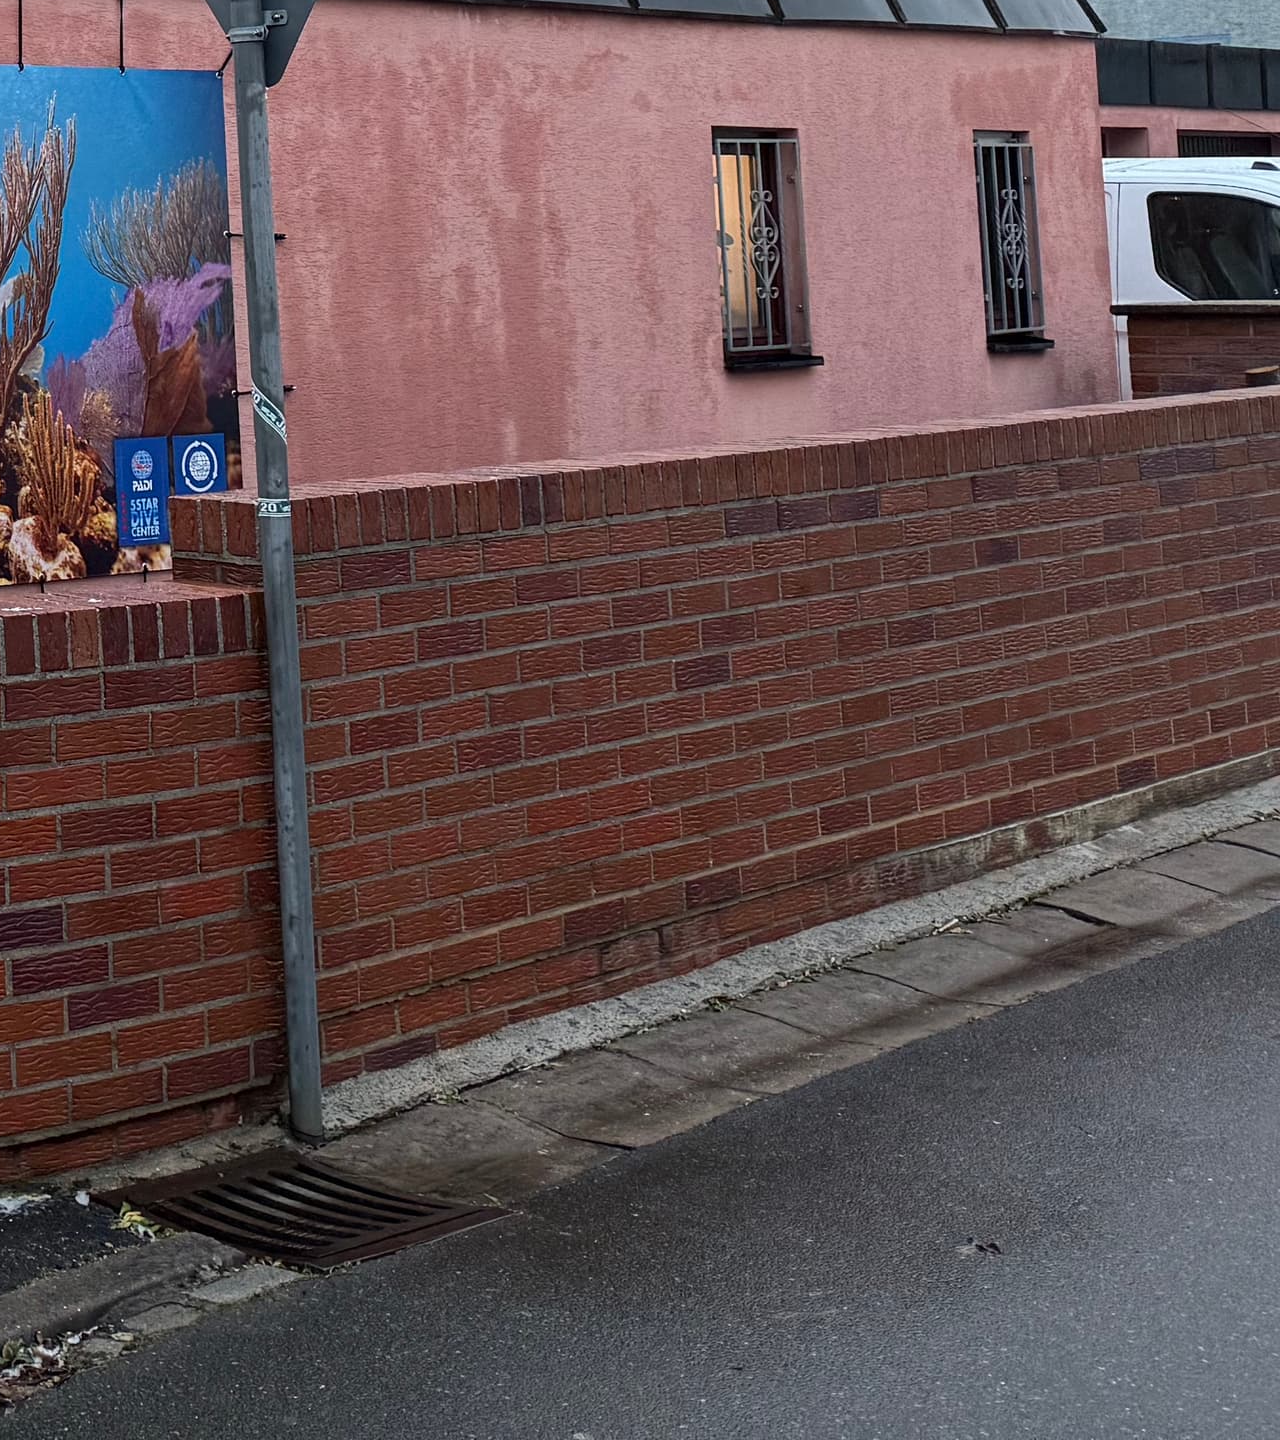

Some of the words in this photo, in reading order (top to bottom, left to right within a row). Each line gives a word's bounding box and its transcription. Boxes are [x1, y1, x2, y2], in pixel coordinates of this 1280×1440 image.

[132, 479, 153, 492] PADI
[131, 511, 160, 527] DIVE
[131, 525, 161, 537] CENTER
